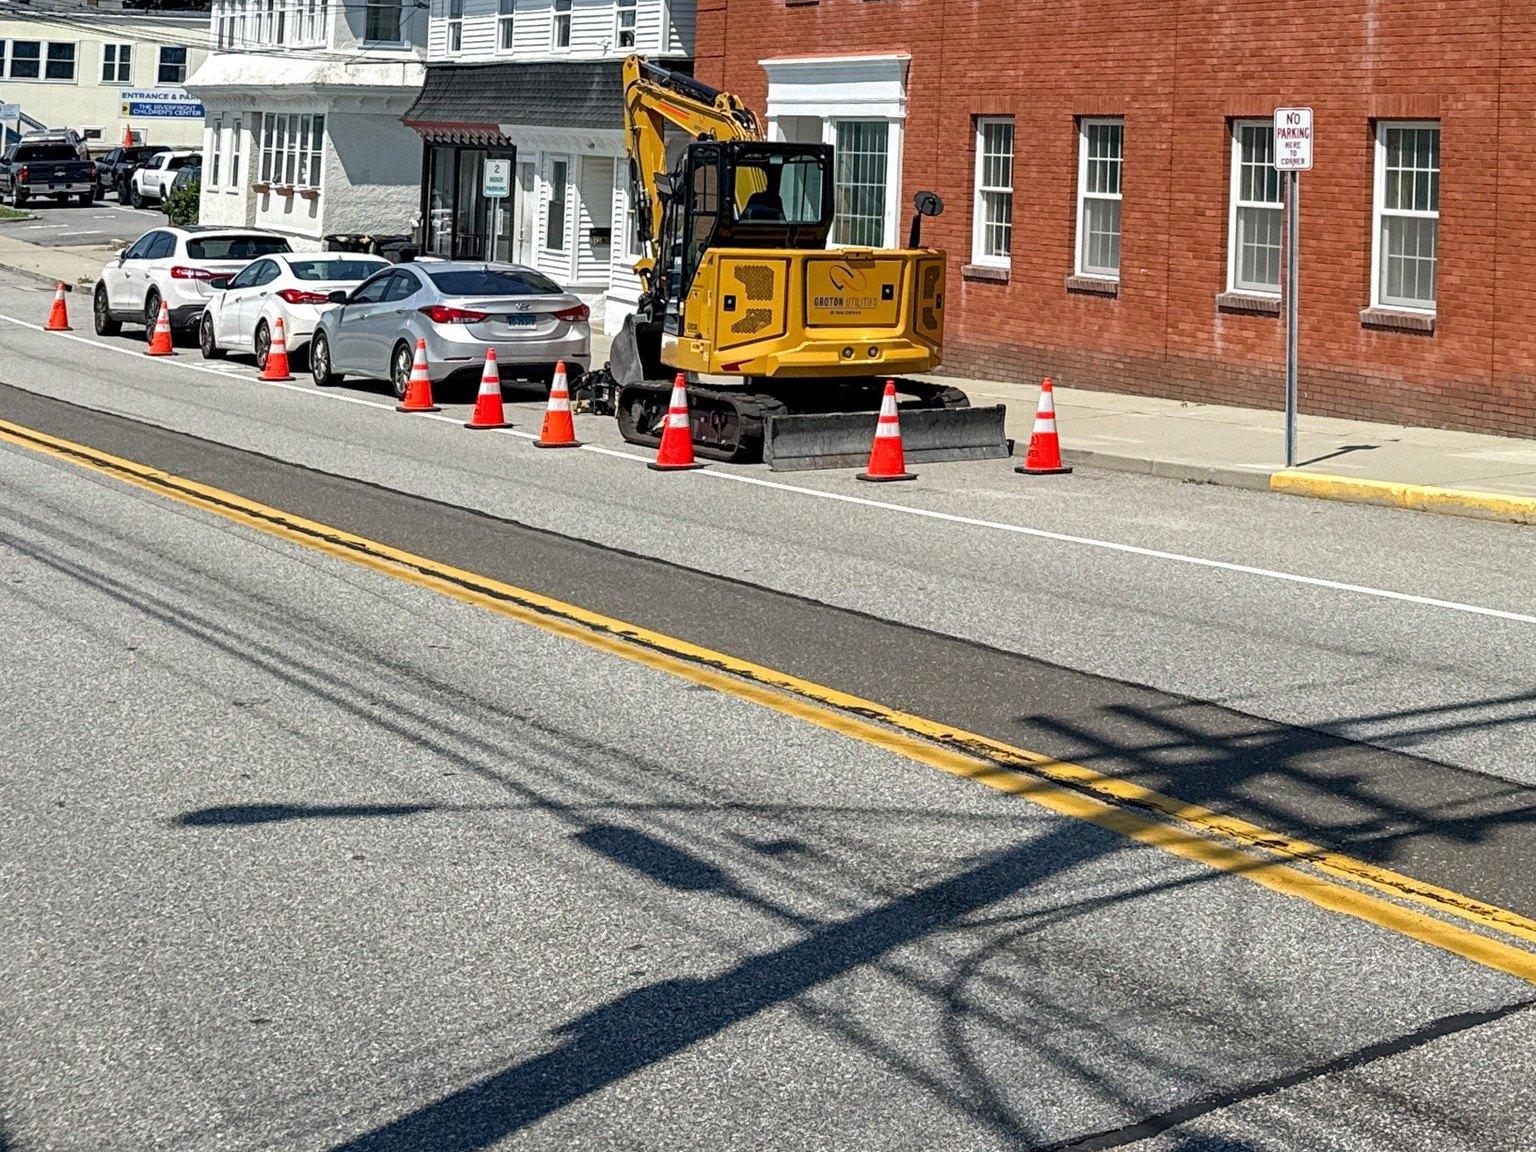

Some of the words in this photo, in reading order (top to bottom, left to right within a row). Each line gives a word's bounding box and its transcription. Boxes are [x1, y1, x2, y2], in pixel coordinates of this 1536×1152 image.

[121, 92, 170, 100] ENTRANCE
[174, 109, 202, 117] CENTER
[1286, 113, 1300, 125] NO
[1277, 127, 1310, 139] PARKING
[1285, 141, 1301, 149] HERE
[1290, 149, 1297, 157] TO
[494, 164, 500, 174] 2
[814, 297, 844, 307] GROTON
[845, 297, 878, 307] UTILITIES
